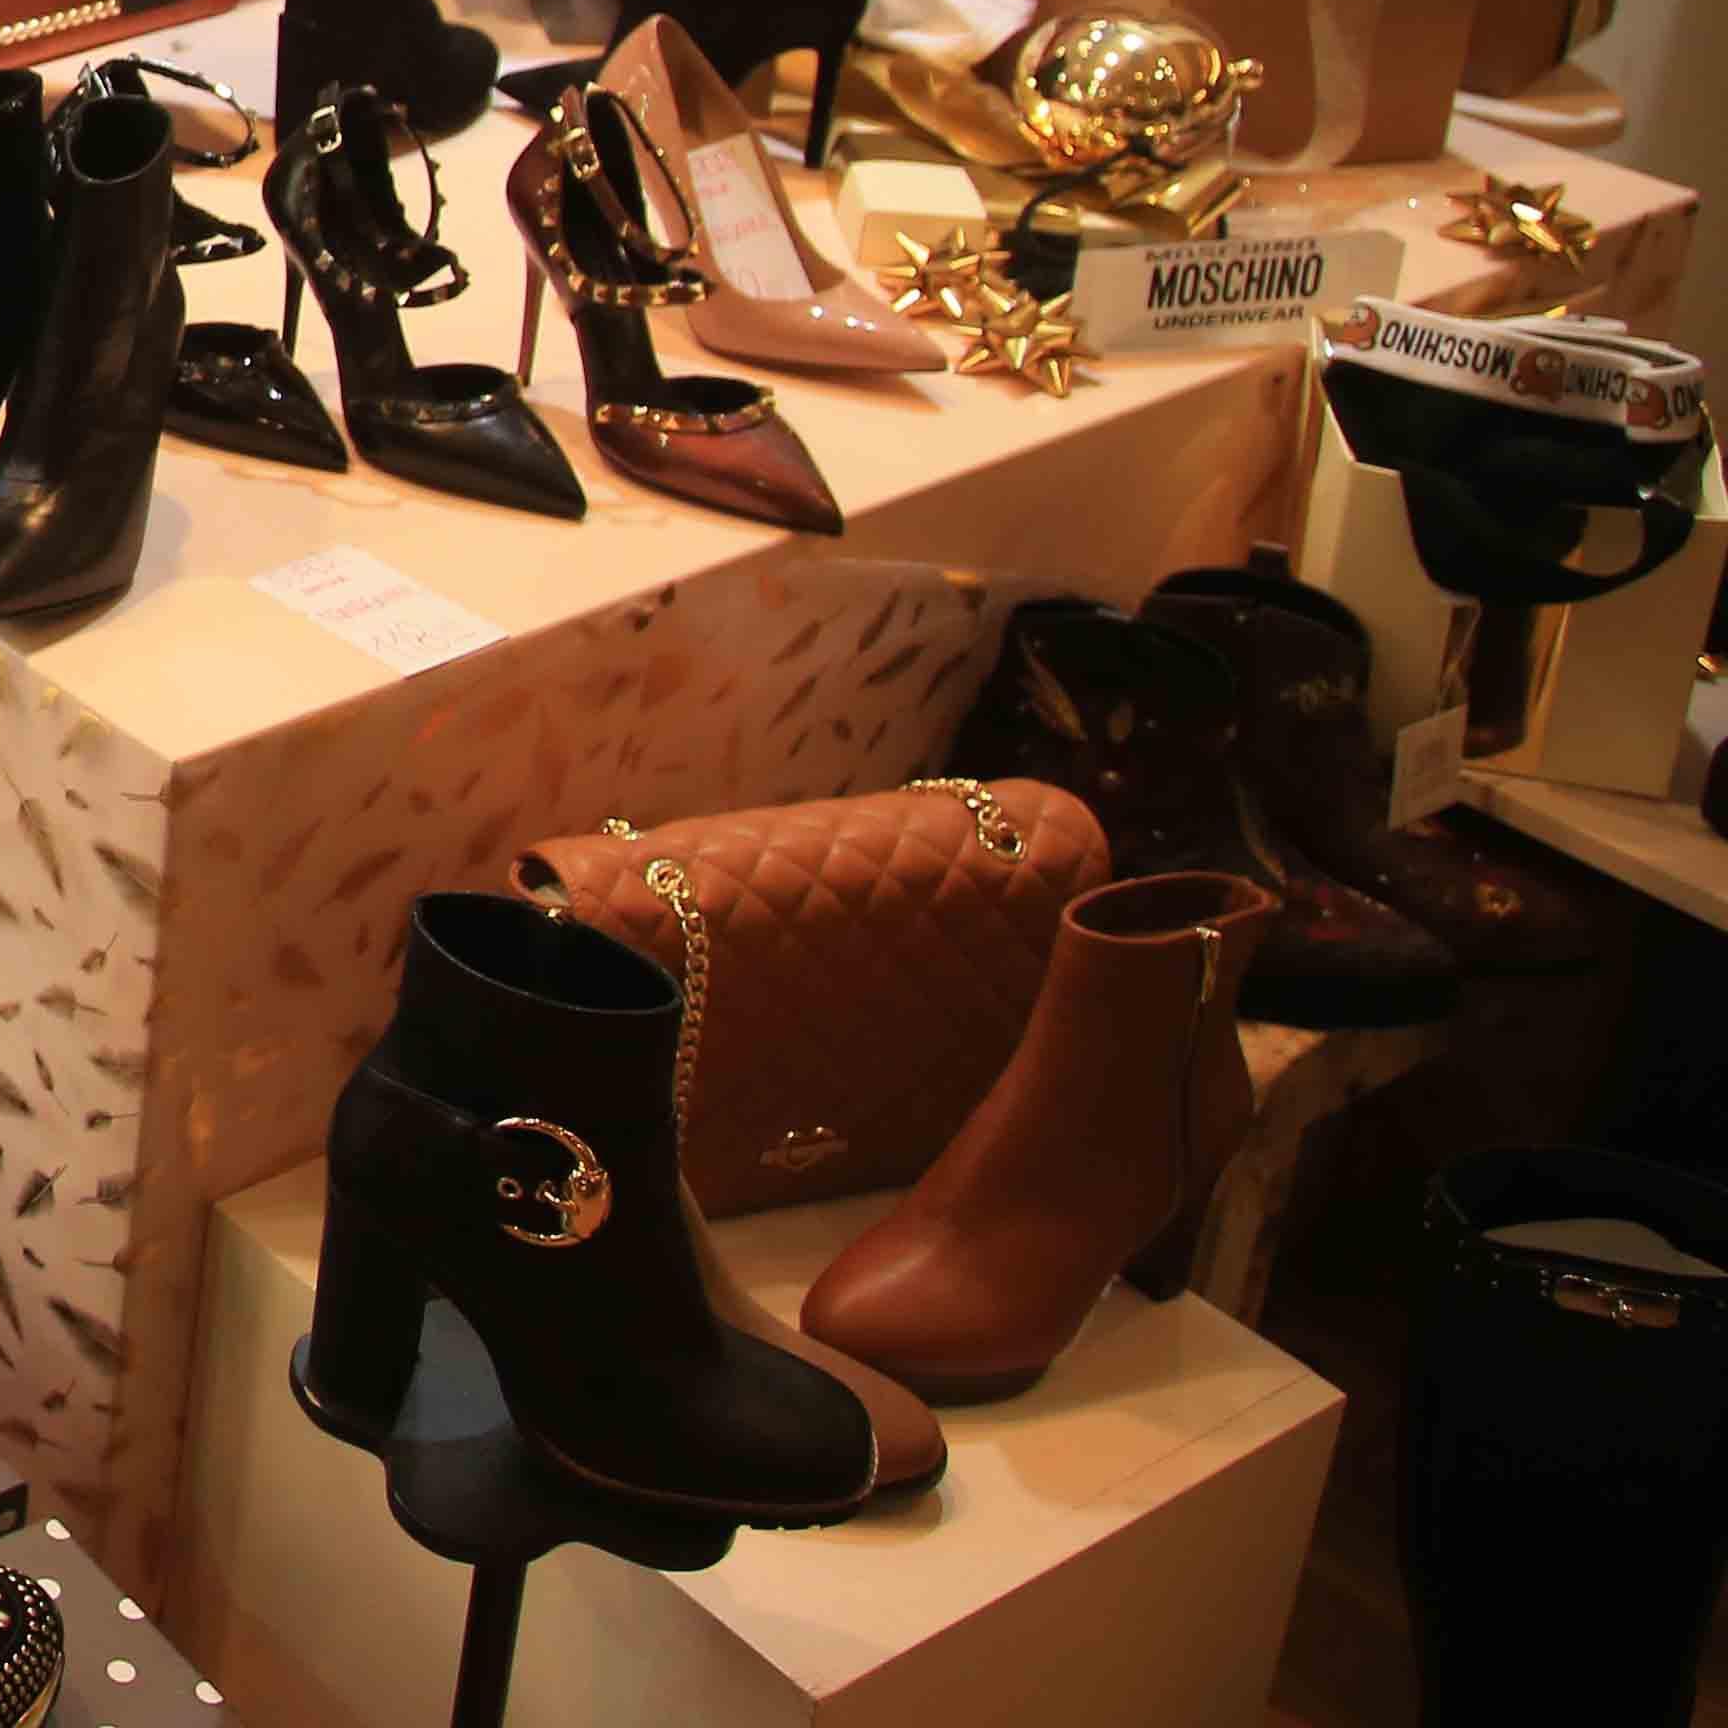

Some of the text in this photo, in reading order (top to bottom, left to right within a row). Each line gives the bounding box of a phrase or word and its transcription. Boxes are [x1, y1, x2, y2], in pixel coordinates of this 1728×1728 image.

[1147, 253, 1324, 309] MOSCHINO
[1153, 305, 1305, 332] UNDERWEAR
[1380, 320, 1518, 381] MOSCHINO
